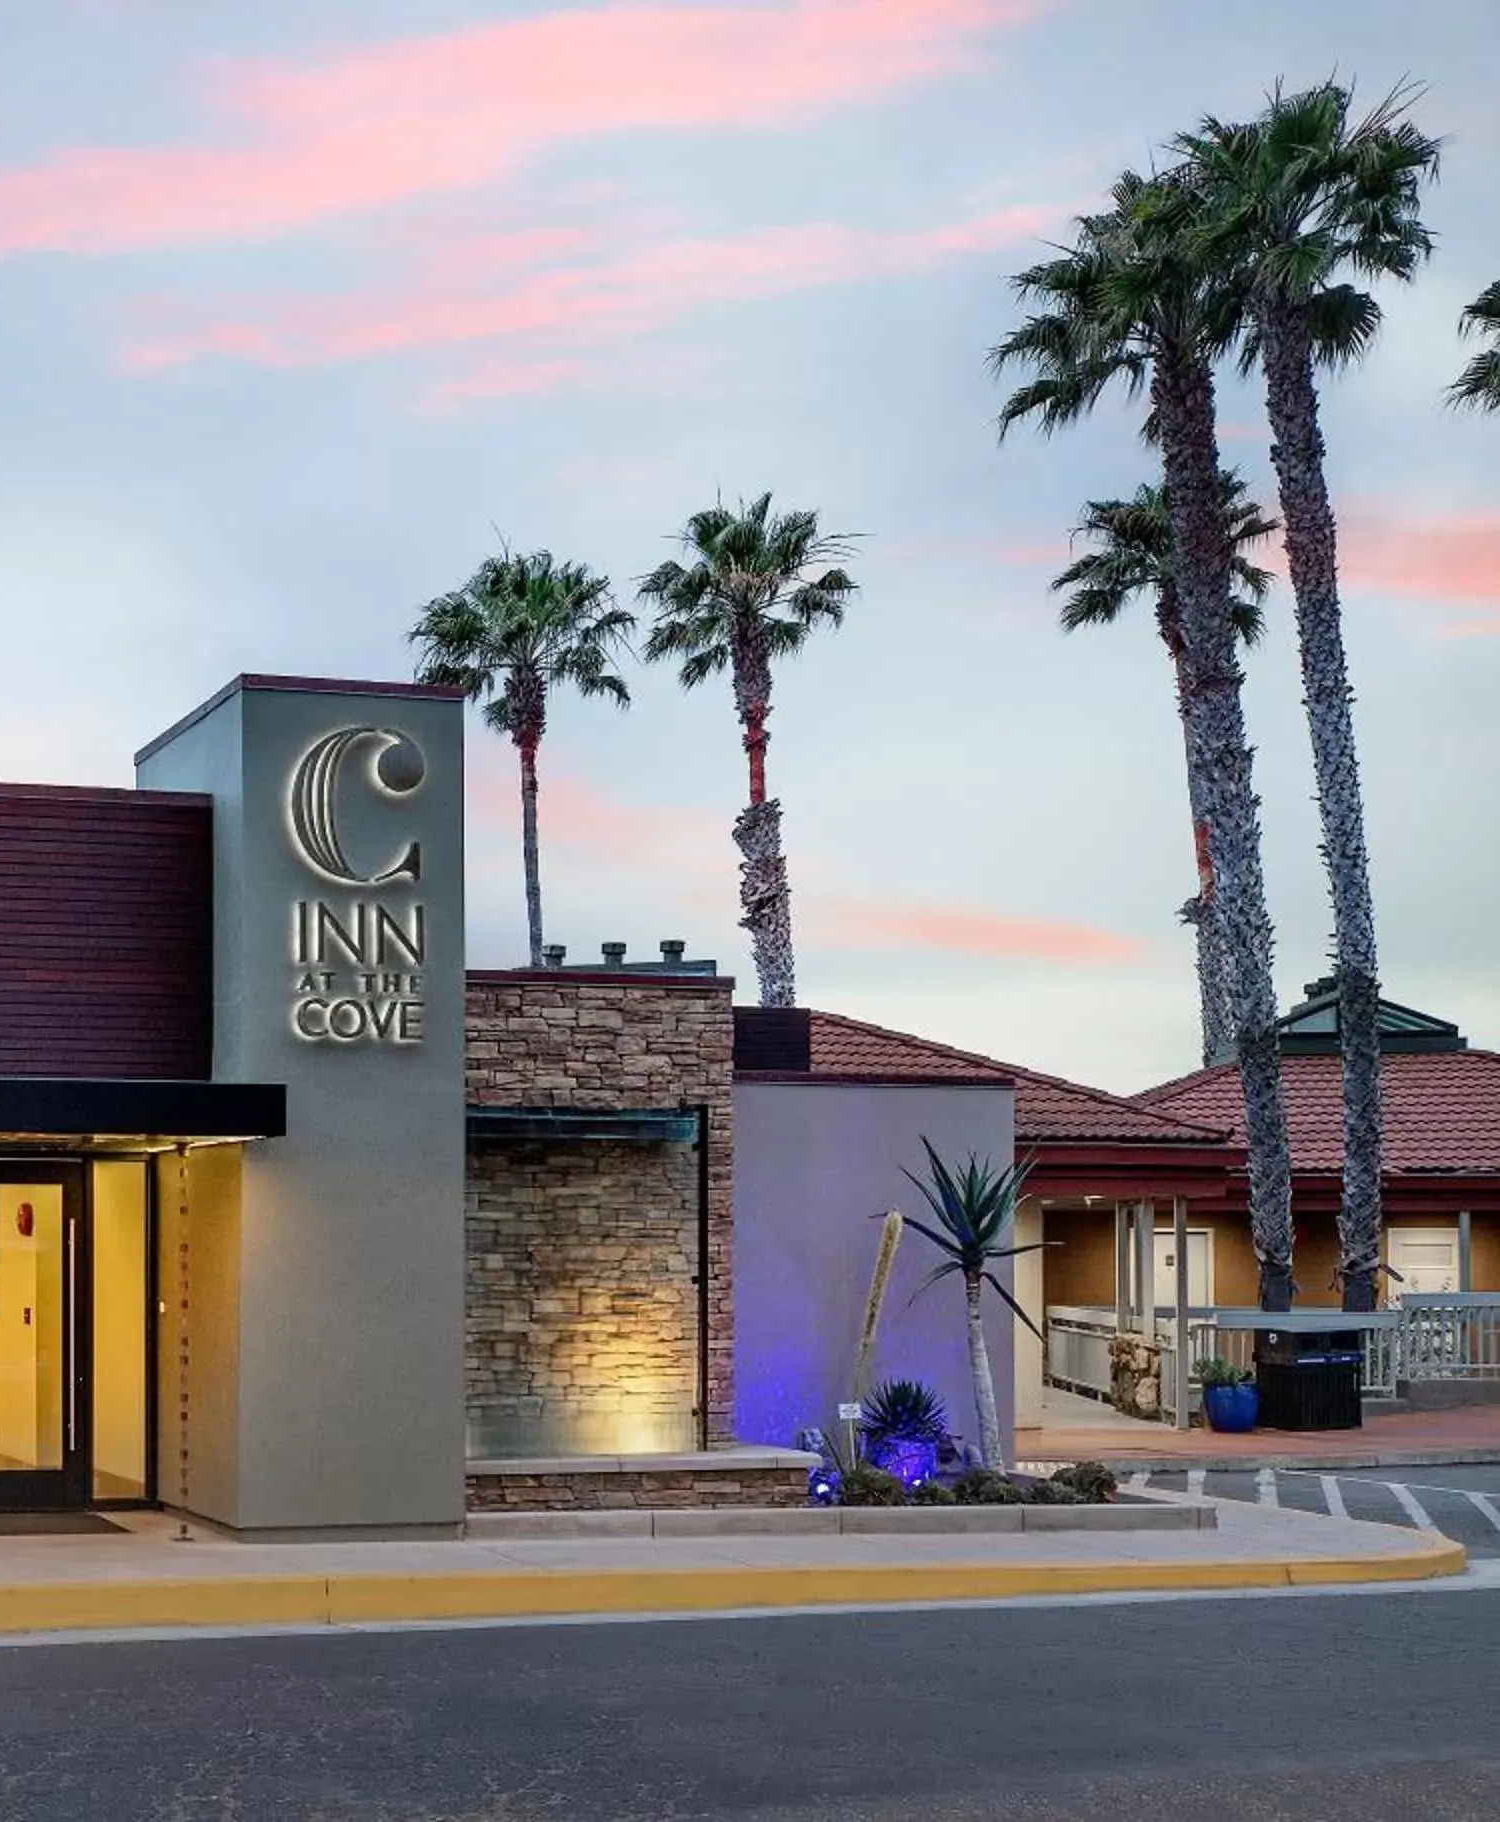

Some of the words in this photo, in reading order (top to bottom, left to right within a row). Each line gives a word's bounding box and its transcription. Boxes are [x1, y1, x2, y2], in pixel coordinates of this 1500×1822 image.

[291, 727, 425, 882] C
[297, 901, 425, 966] INN
[297, 971, 337, 992] AT
[360, 972, 423, 994] THE
[296, 997, 426, 1040] COVE
